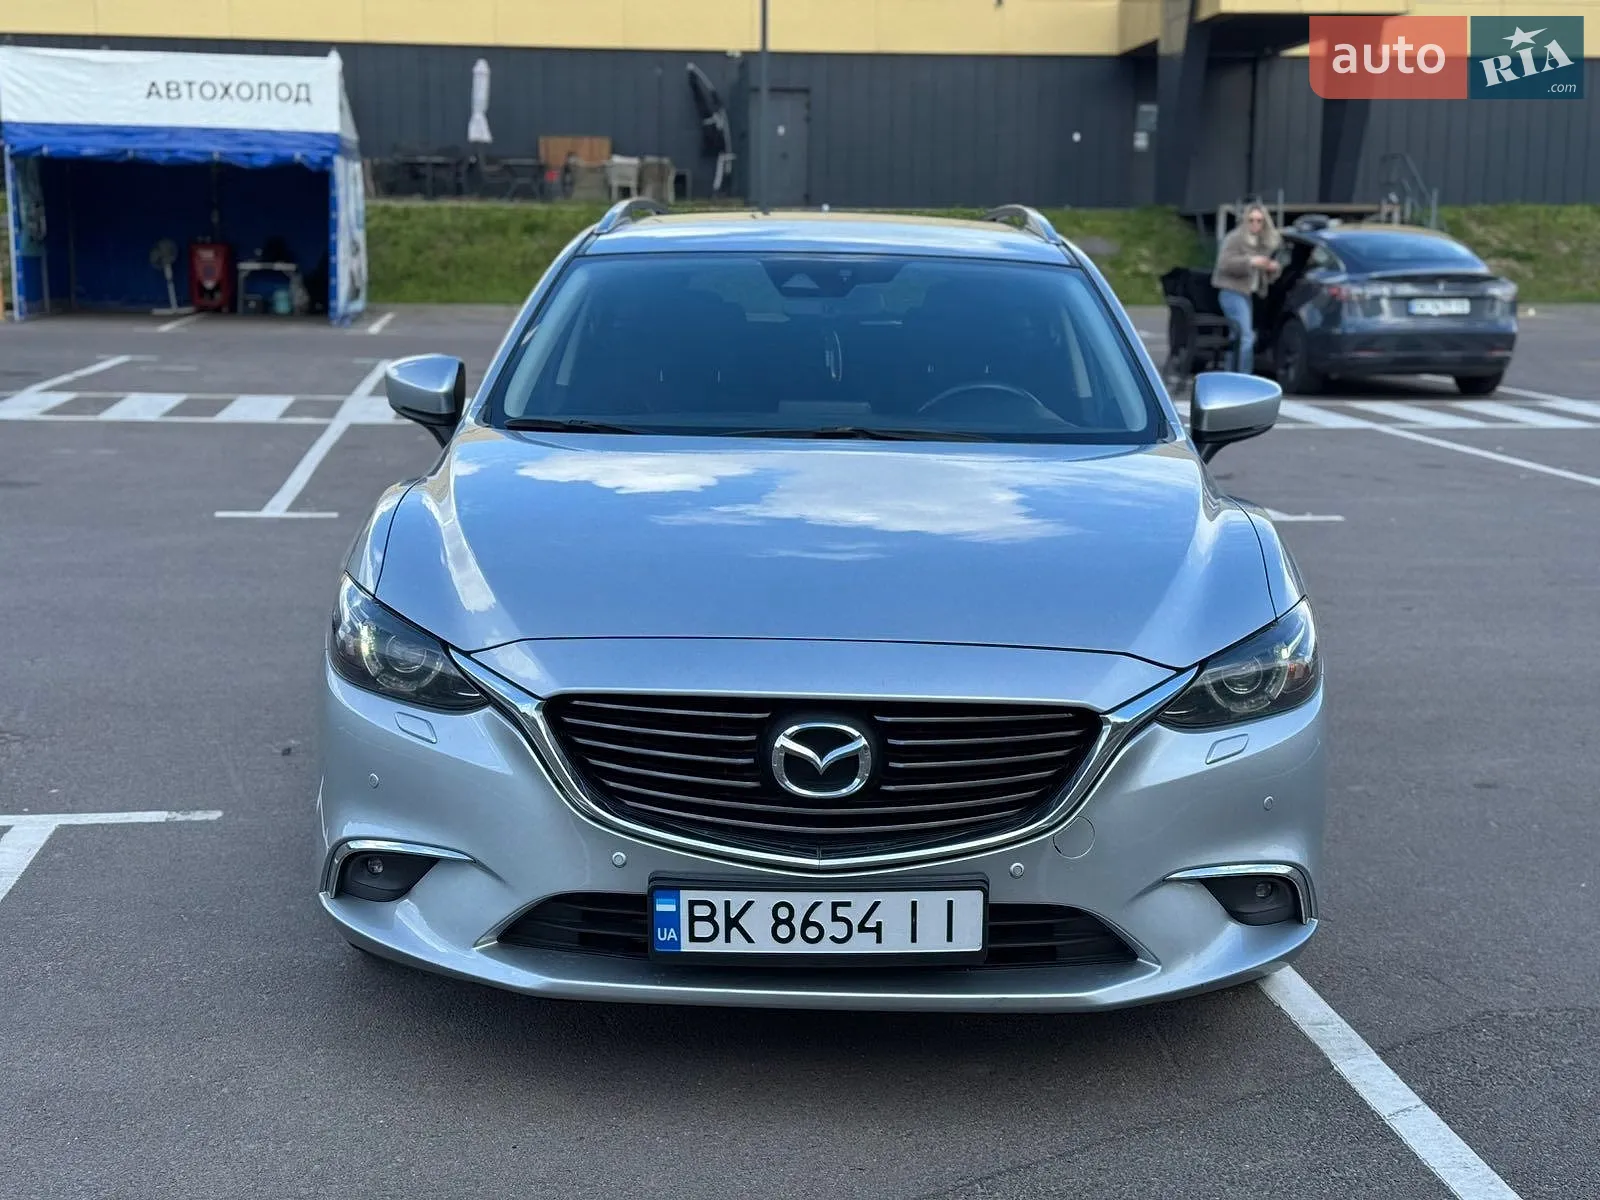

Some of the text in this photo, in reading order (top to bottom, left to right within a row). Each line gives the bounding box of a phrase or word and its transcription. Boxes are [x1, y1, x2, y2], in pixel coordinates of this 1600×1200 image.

[146, 79, 313, 105] АВТОХОЛОД
[657, 927, 678, 942] UA
[687, 899, 756, 944] BK
[770, 900, 883, 944] 8654
